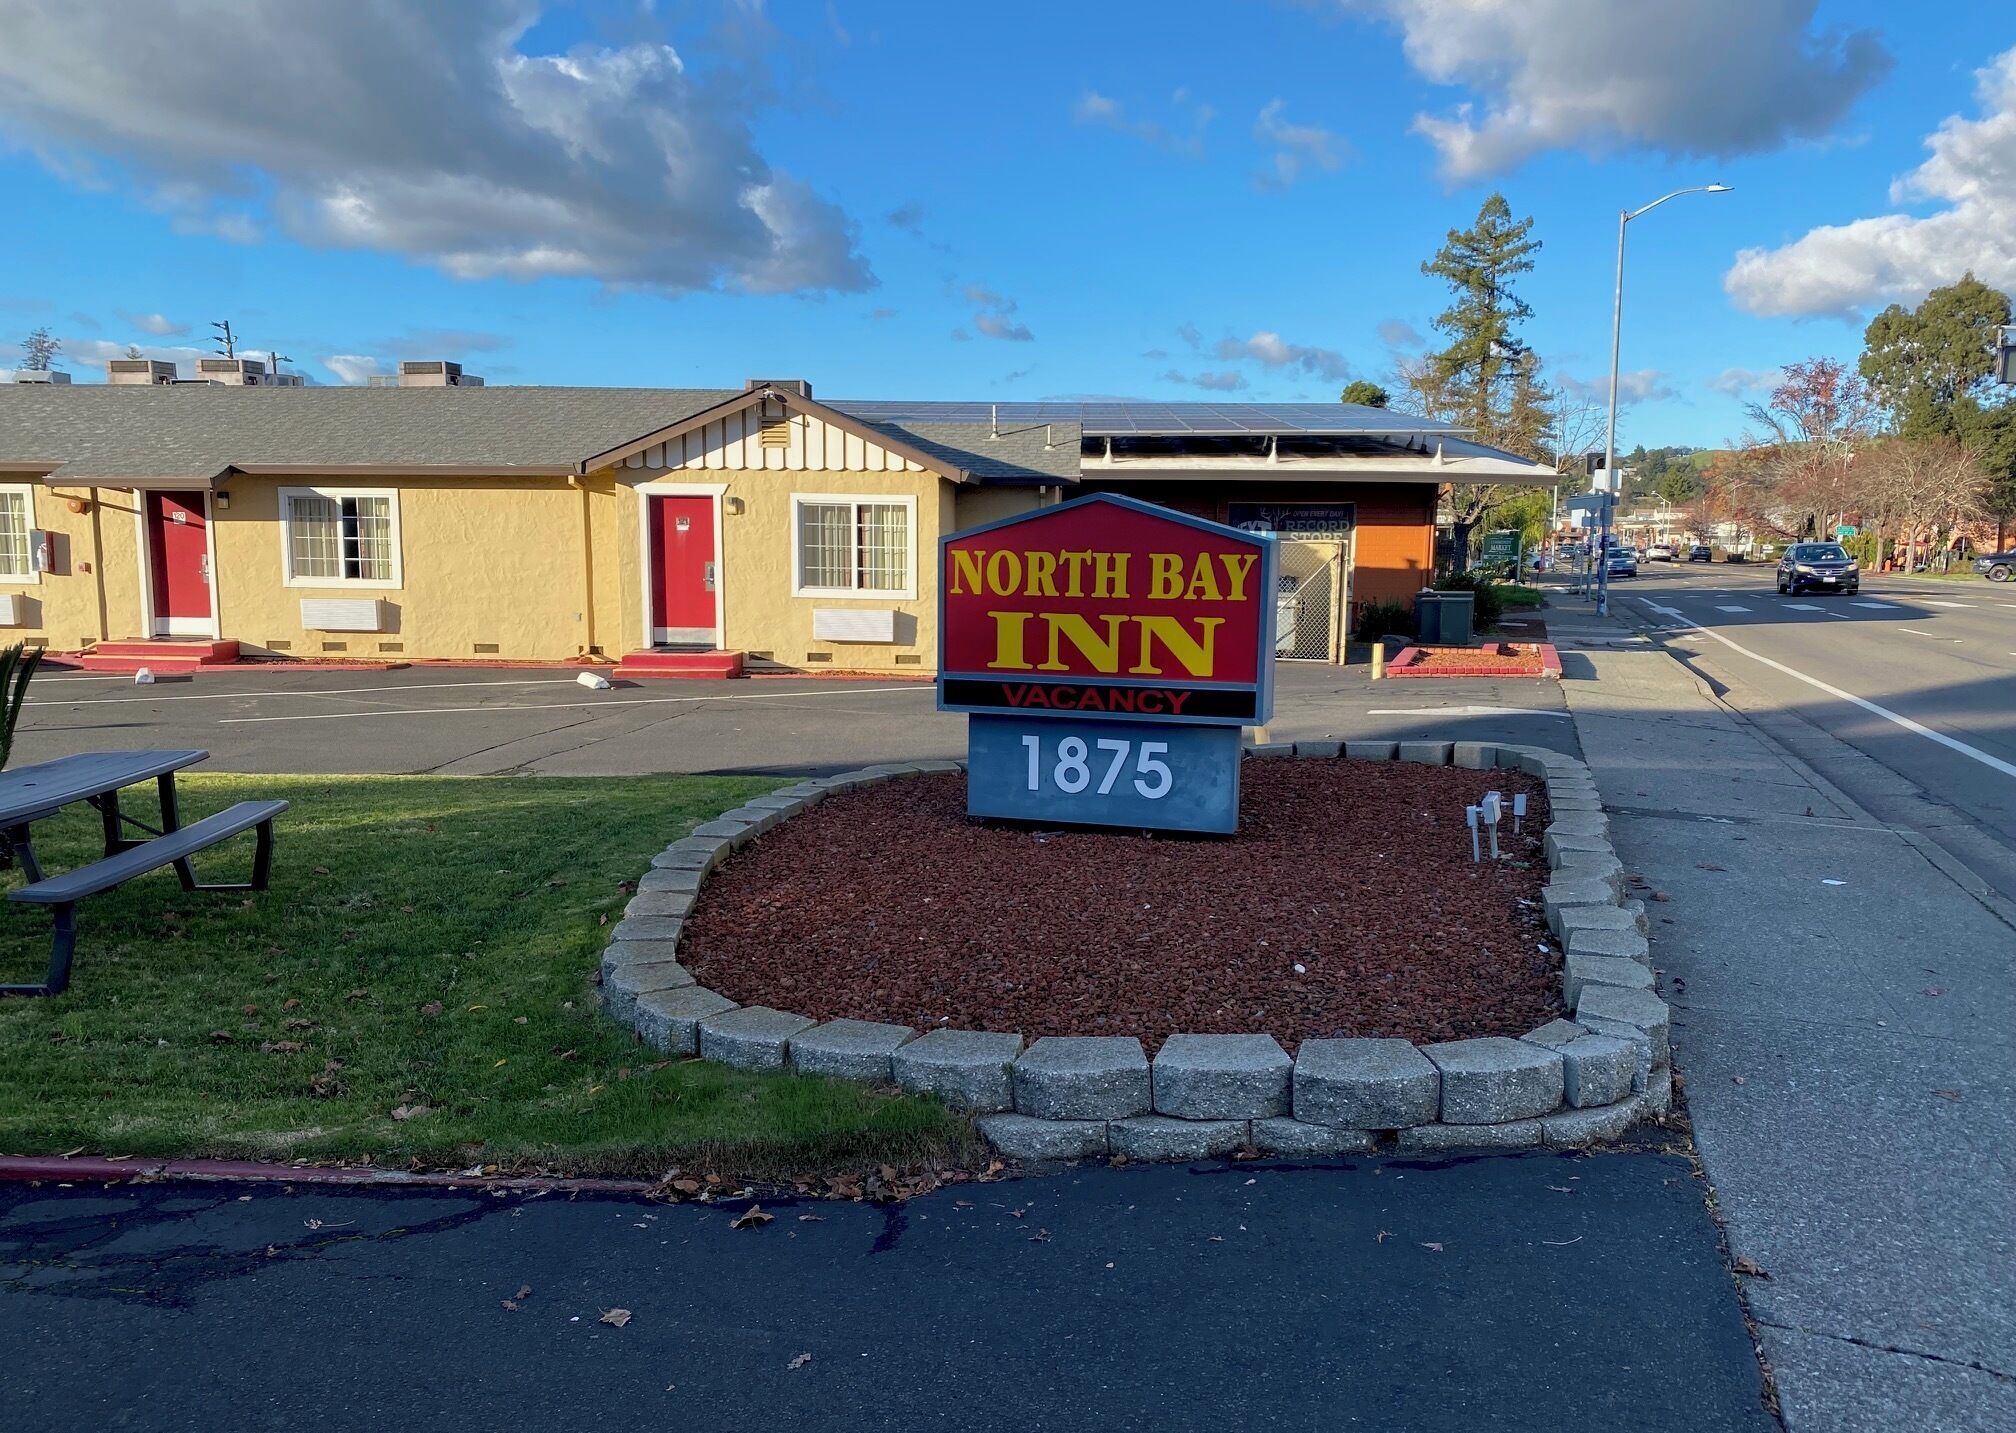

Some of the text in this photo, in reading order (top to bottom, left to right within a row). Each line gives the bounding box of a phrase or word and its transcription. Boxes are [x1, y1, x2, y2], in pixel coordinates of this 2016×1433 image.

[1285, 519, 1350, 532] RECORD
[1290, 532, 1343, 540] STORE
[950, 548, 1258, 601] NORTH BAY
[987, 610, 1226, 677] INN
[1001, 683, 1192, 715] VACANCY
[1021, 734, 1173, 800] 1875
